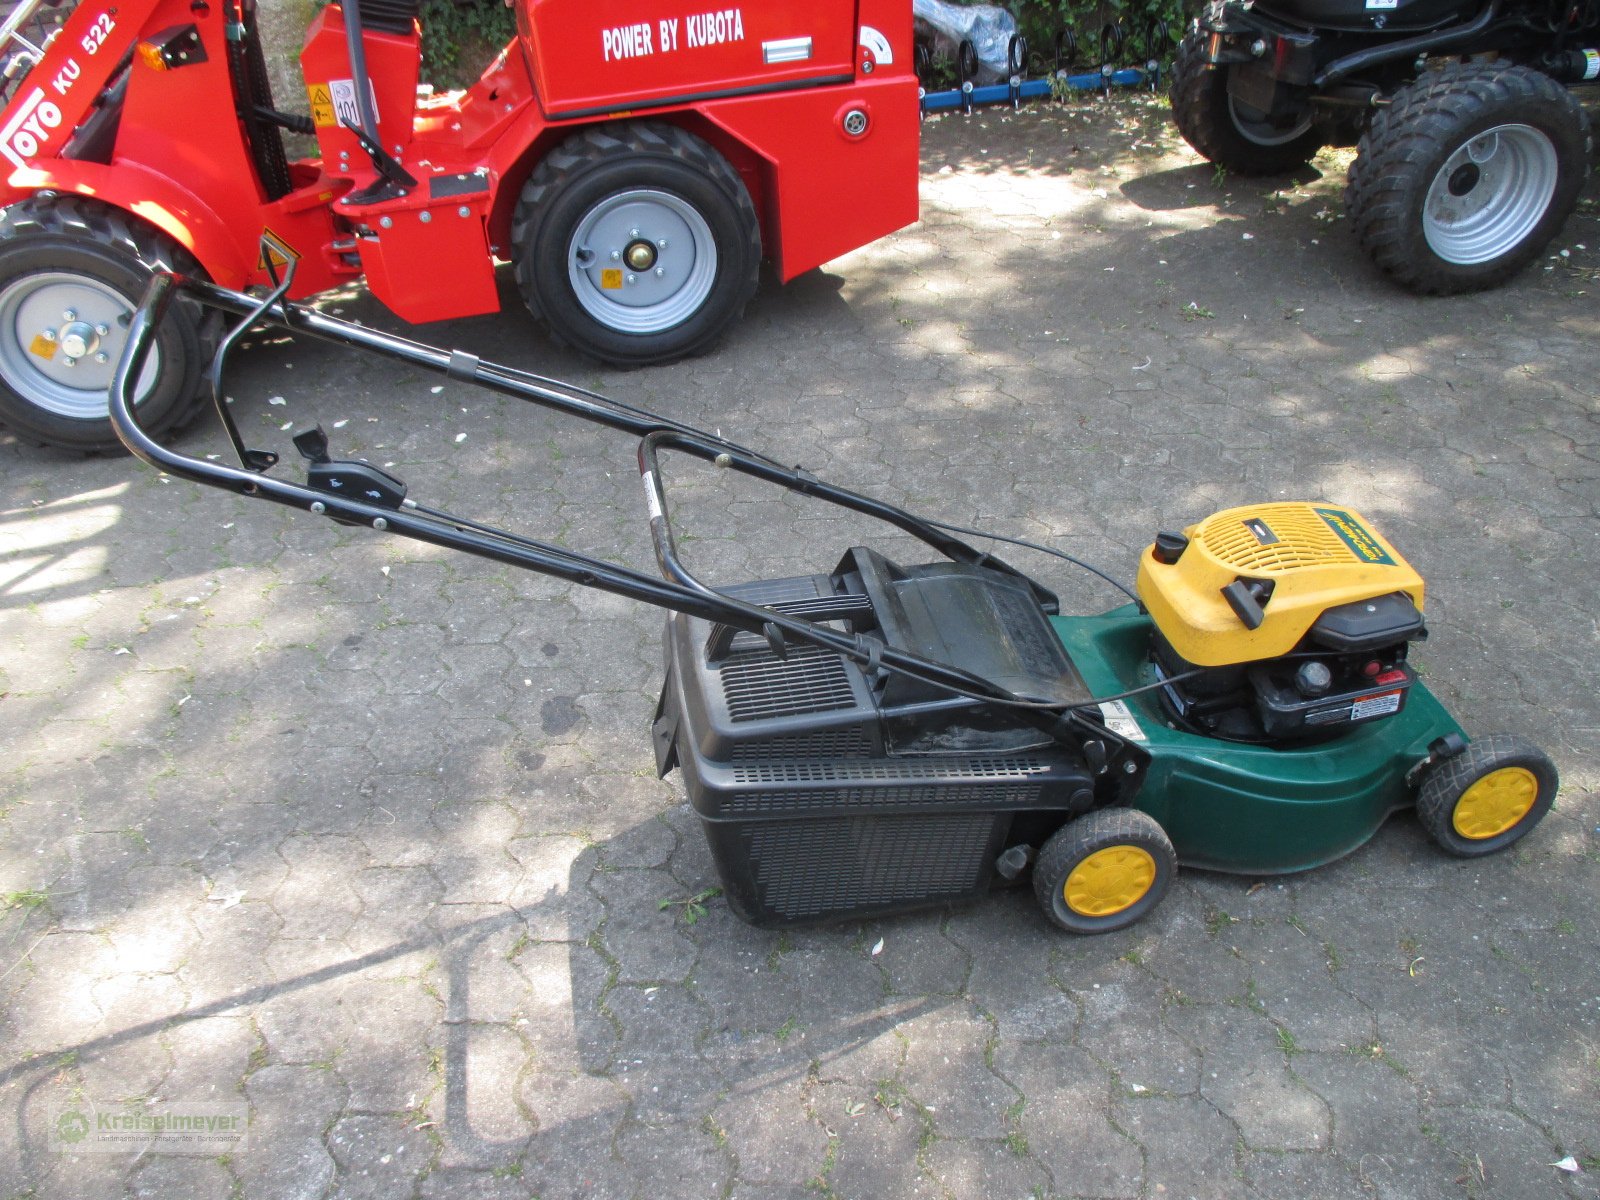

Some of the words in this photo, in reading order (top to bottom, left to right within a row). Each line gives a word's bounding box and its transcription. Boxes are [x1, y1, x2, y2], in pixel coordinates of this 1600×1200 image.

[53, 58, 81, 95] KU
[82, 13, 116, 55] 522
[602, 23, 653, 61] POWER
[659, 18, 678, 52] BY
[686, 9, 744, 48] KUBOTA
